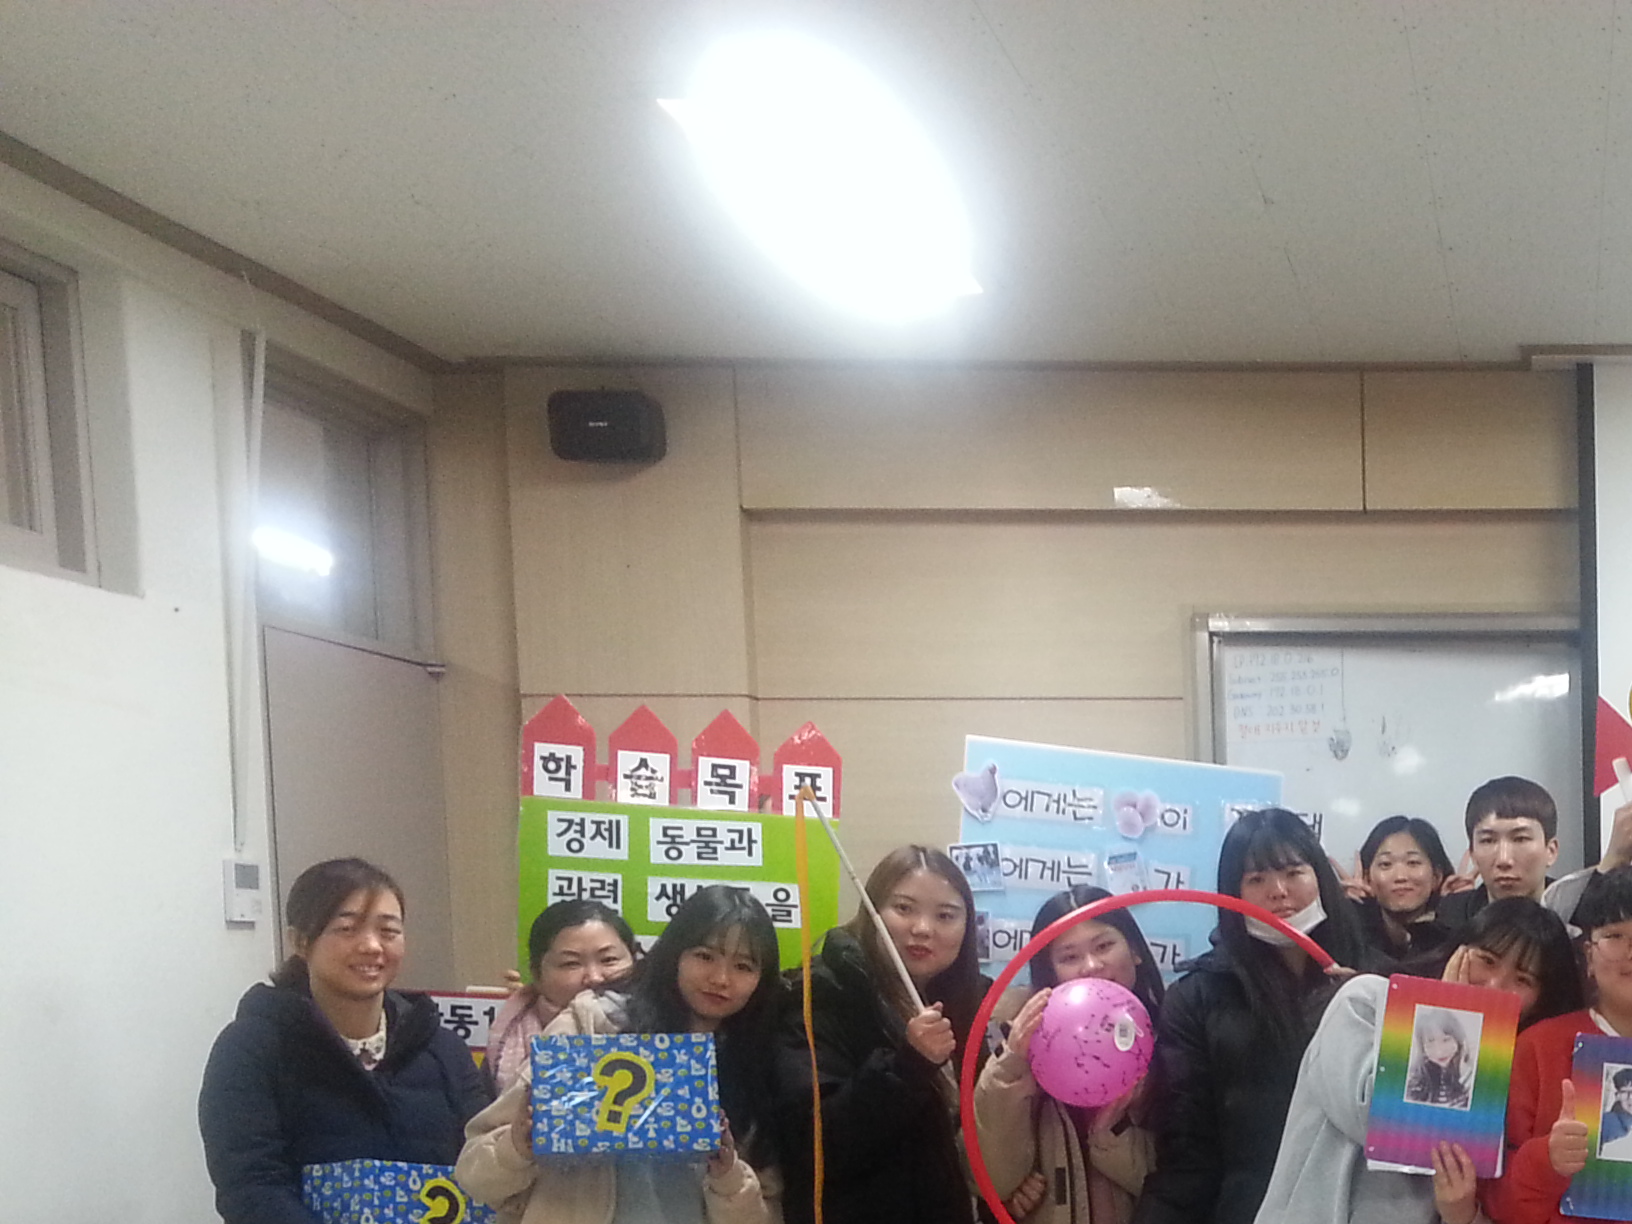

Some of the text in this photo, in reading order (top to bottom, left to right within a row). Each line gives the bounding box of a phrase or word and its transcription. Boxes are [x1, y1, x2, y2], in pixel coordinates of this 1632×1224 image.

[1002, 787, 1098, 822] 에게는
[555, 814, 758, 861] 경제 동물과
